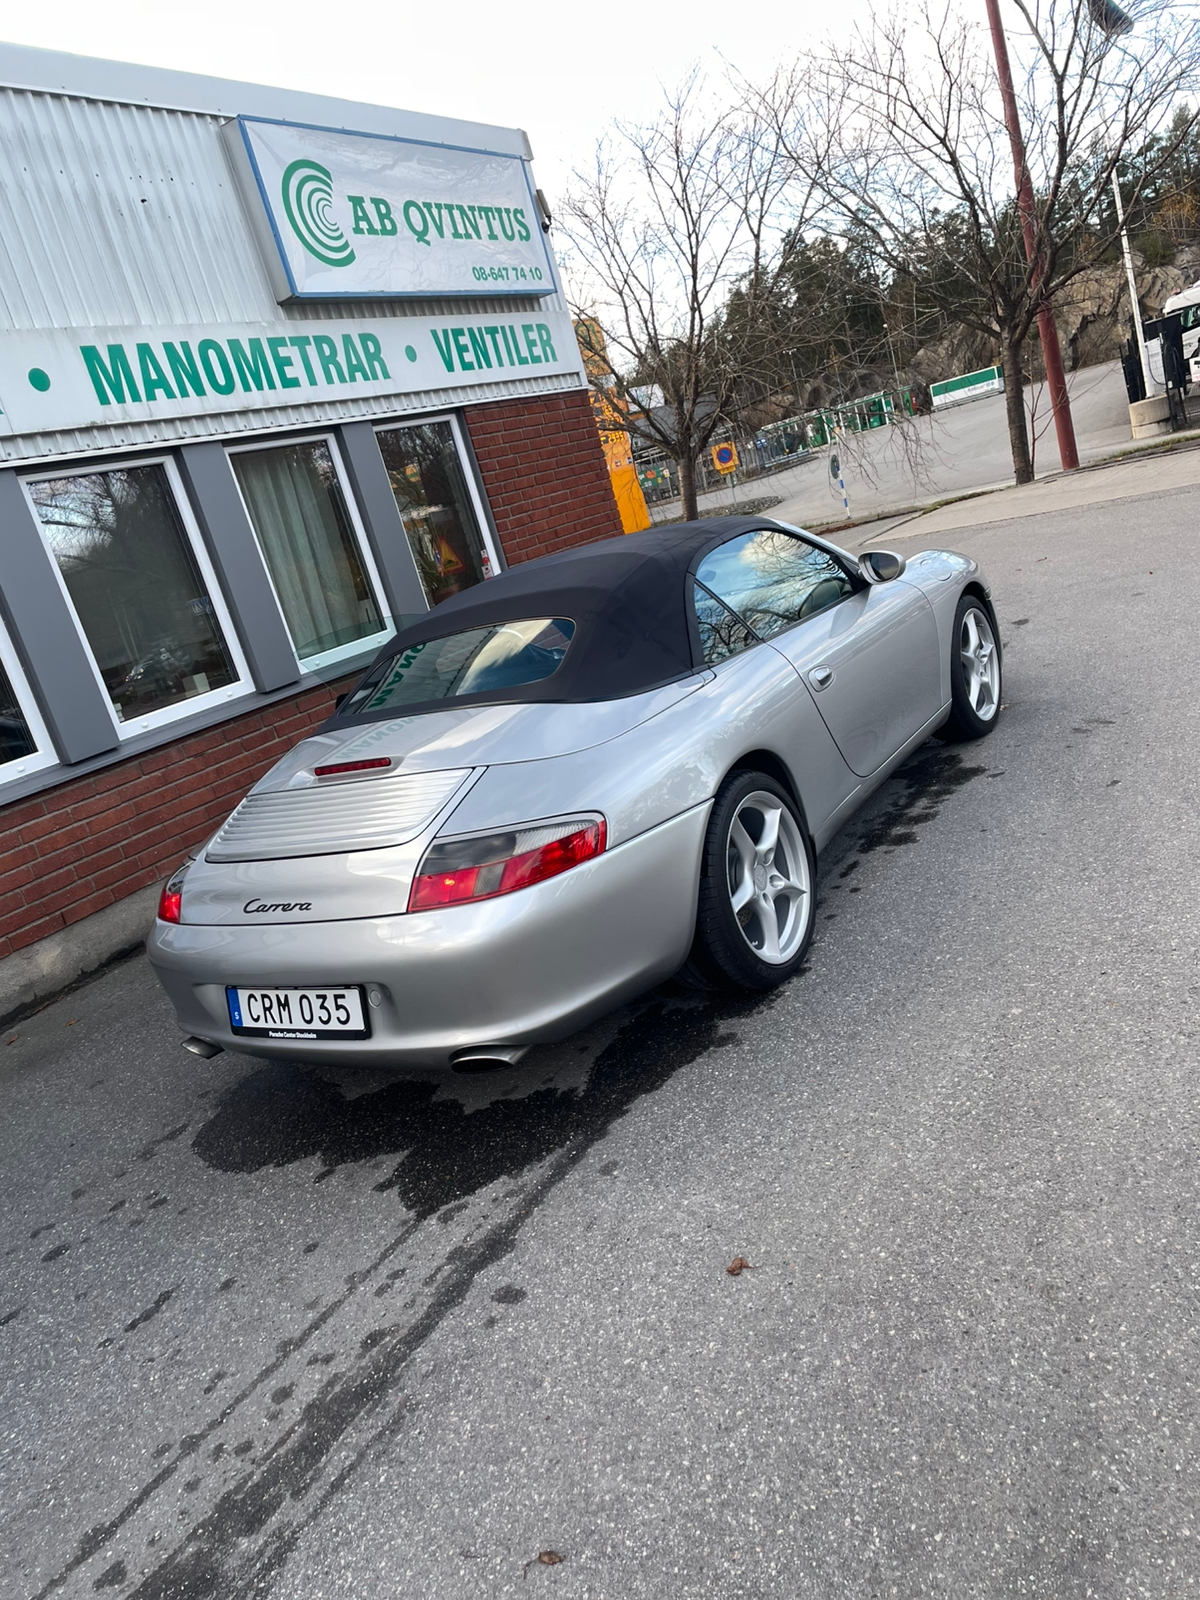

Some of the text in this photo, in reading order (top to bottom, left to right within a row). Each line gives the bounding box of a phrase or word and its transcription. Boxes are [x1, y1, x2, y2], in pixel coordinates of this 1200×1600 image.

[348, 196, 531, 245] AB QVINTUS
[472, 267, 542, 281] 08-647 74 10
[80, 324, 556, 405] MANOMETRAR VENTILER
[243, 898, 312, 914] Carrera
[234, 1011, 240, 1020] S
[247, 993, 351, 1025] CRM 035
